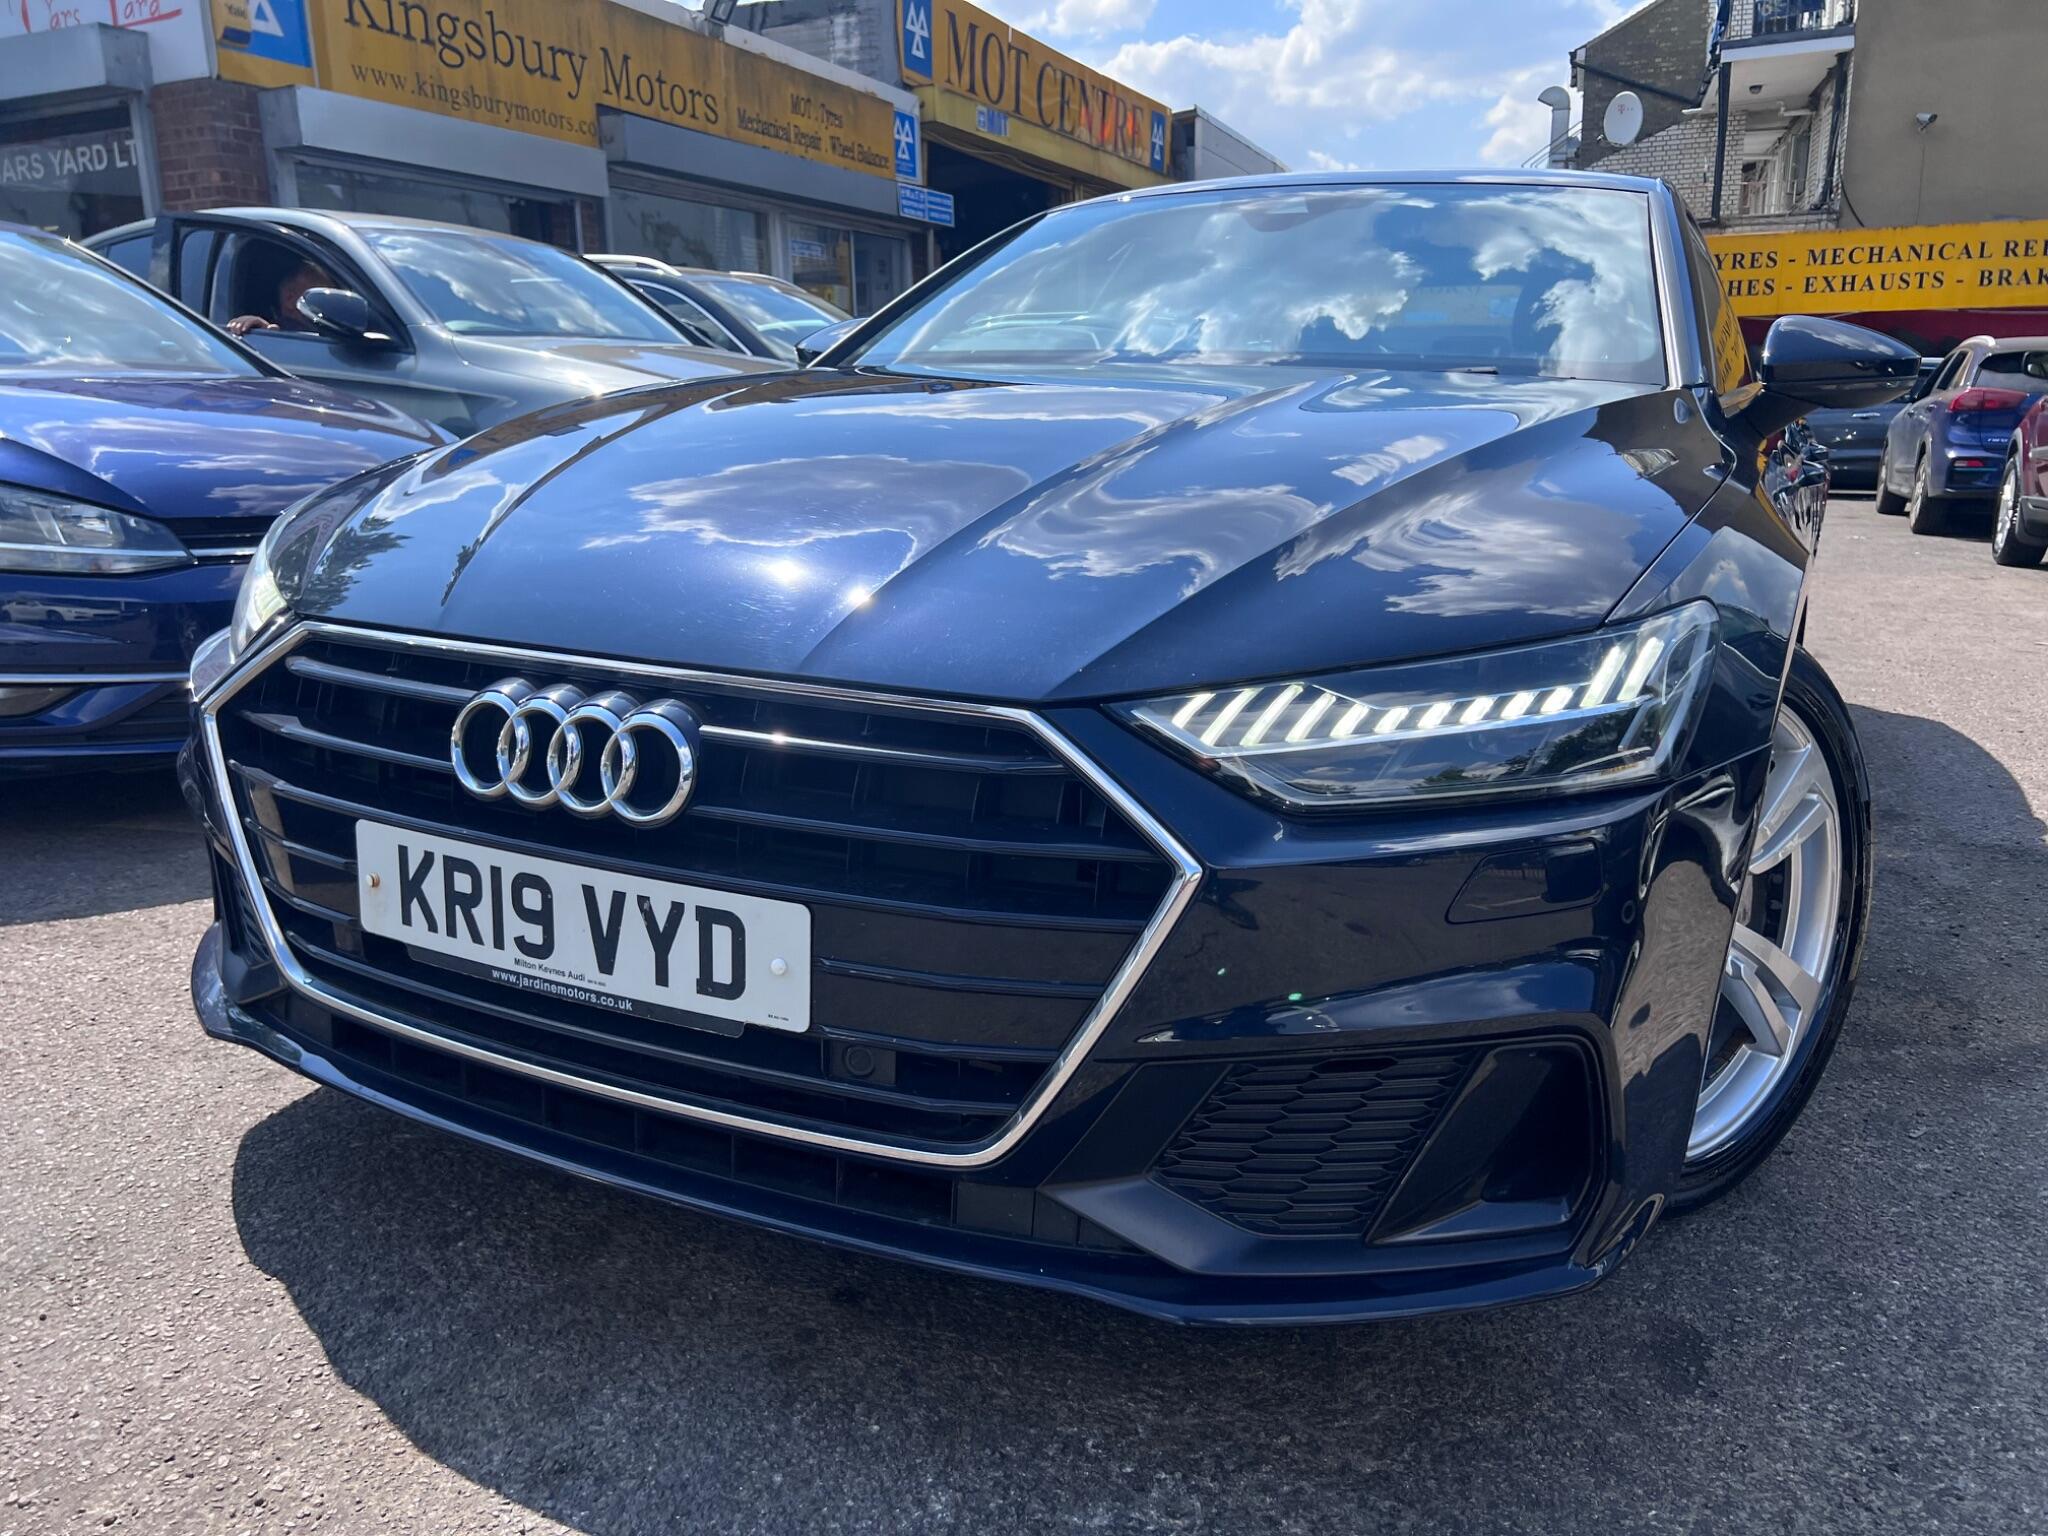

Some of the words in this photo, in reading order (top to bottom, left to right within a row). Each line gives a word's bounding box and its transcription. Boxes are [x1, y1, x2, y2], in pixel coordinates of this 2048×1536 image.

[600, 47, 719, 125] Motors
[945, 9, 1029, 117] MOT
[1037, 62, 1144, 158] CENTRE
[790, 93, 812, 120] MOT
[820, 103, 843, 130] Tyres
[737, 107, 791, 143] Mechanical
[793, 124, 822, 153] Repair
[830, 135, 855, 162] Wheel
[858, 143, 889, 169] Balance
[48, 143, 109, 177] YARD
[1805, 239, 1993, 266] MECHANICAL
[1803, 270, 1946, 294] EXHAUSTS
[398, 844, 555, 961] KR19
[581, 883, 746, 1001] VYD
[491, 968, 633, 1011] www.jardinemotors.co.uk
[513, 957, 537, 970] Milton
[537, 963, 566, 978] Keynes
[567, 970, 586, 982] Audi
